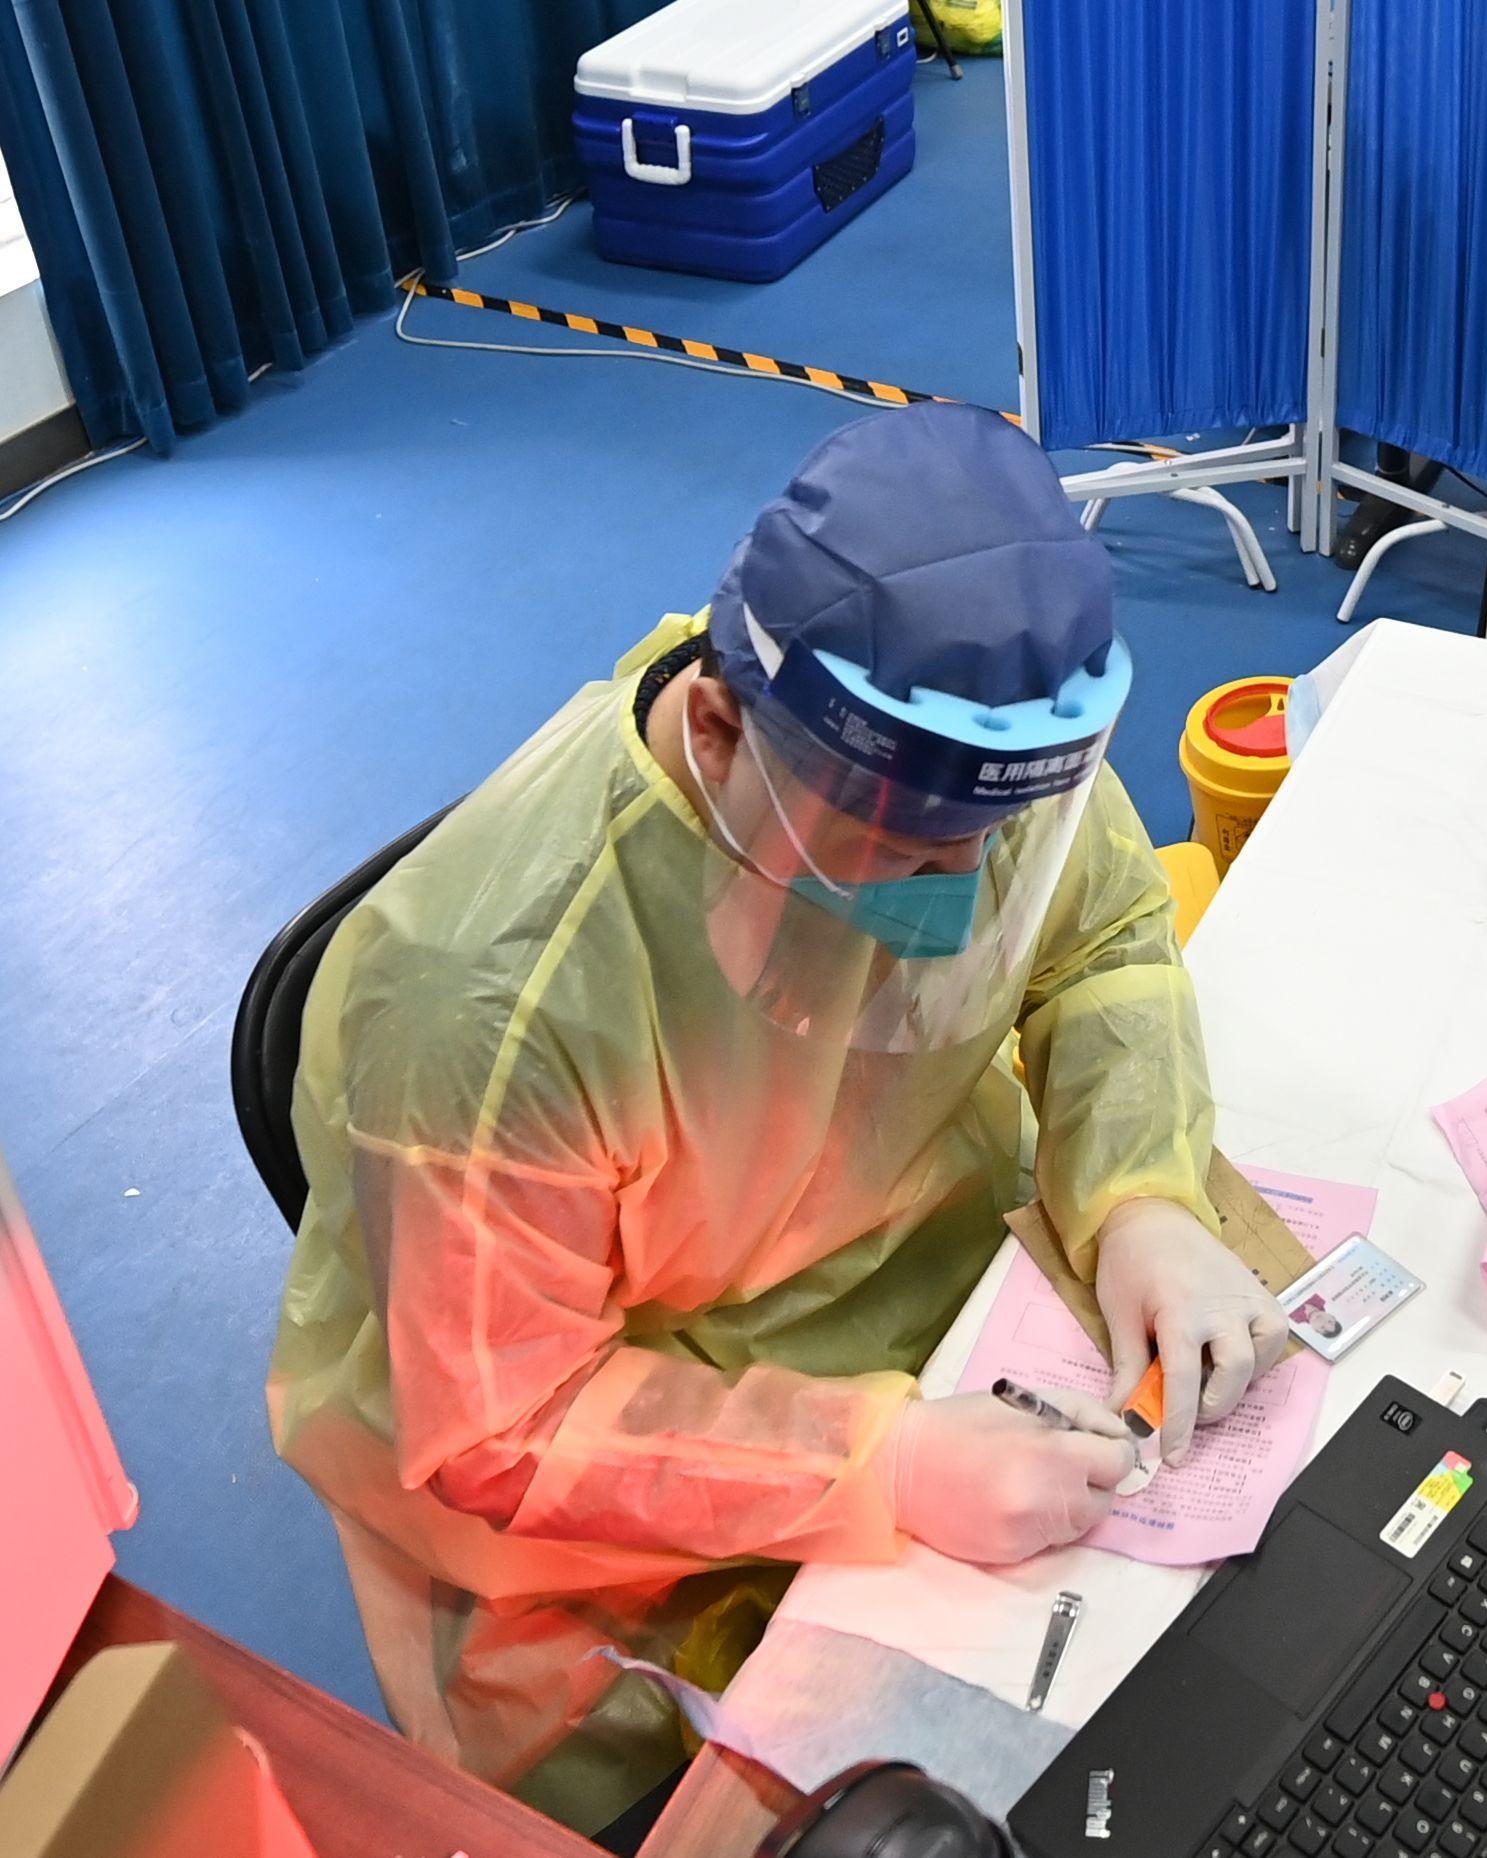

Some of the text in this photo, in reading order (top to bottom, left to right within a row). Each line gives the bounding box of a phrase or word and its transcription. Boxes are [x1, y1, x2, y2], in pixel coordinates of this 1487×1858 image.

[1461, 1624, 1473, 1637] C
[1442, 1652, 1454, 1665] V
[1378, 1734, 1392, 1750] M
[1422, 1743, 1432, 1756] J
[1459, 1759, 1472, 1773] U
[1401, 1772, 1413, 1786] K
[1379, 1801, 1392, 1812] L
[1416, 1819, 1430, 1834] O
